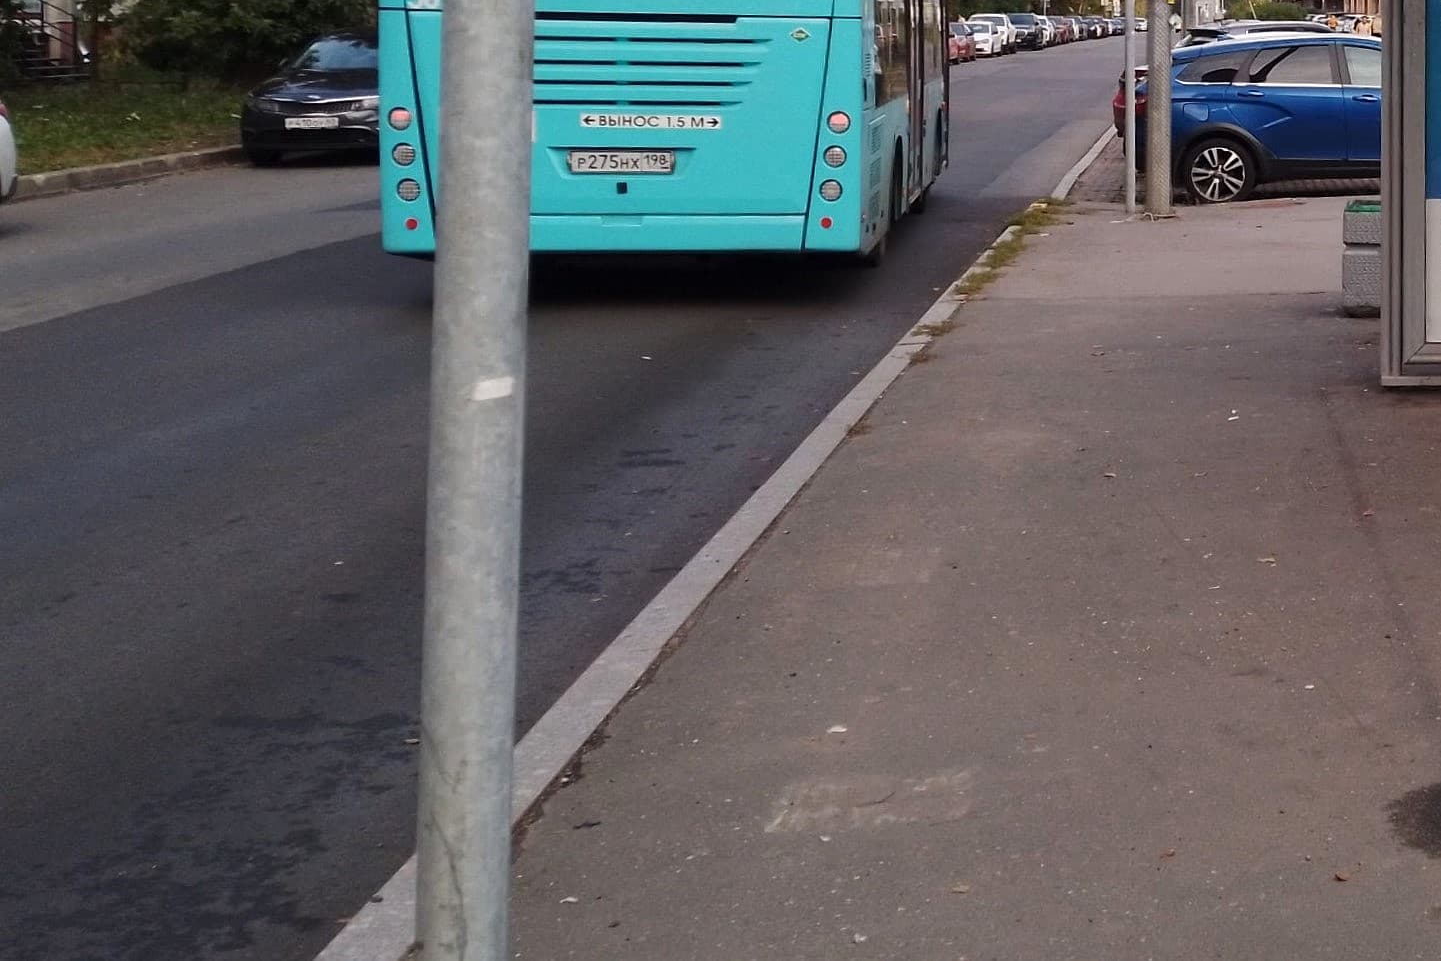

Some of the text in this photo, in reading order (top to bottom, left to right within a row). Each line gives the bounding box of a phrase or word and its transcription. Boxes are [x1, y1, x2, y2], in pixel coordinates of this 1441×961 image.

[598, 115, 704, 128] ВЫНОС 1.5 М
